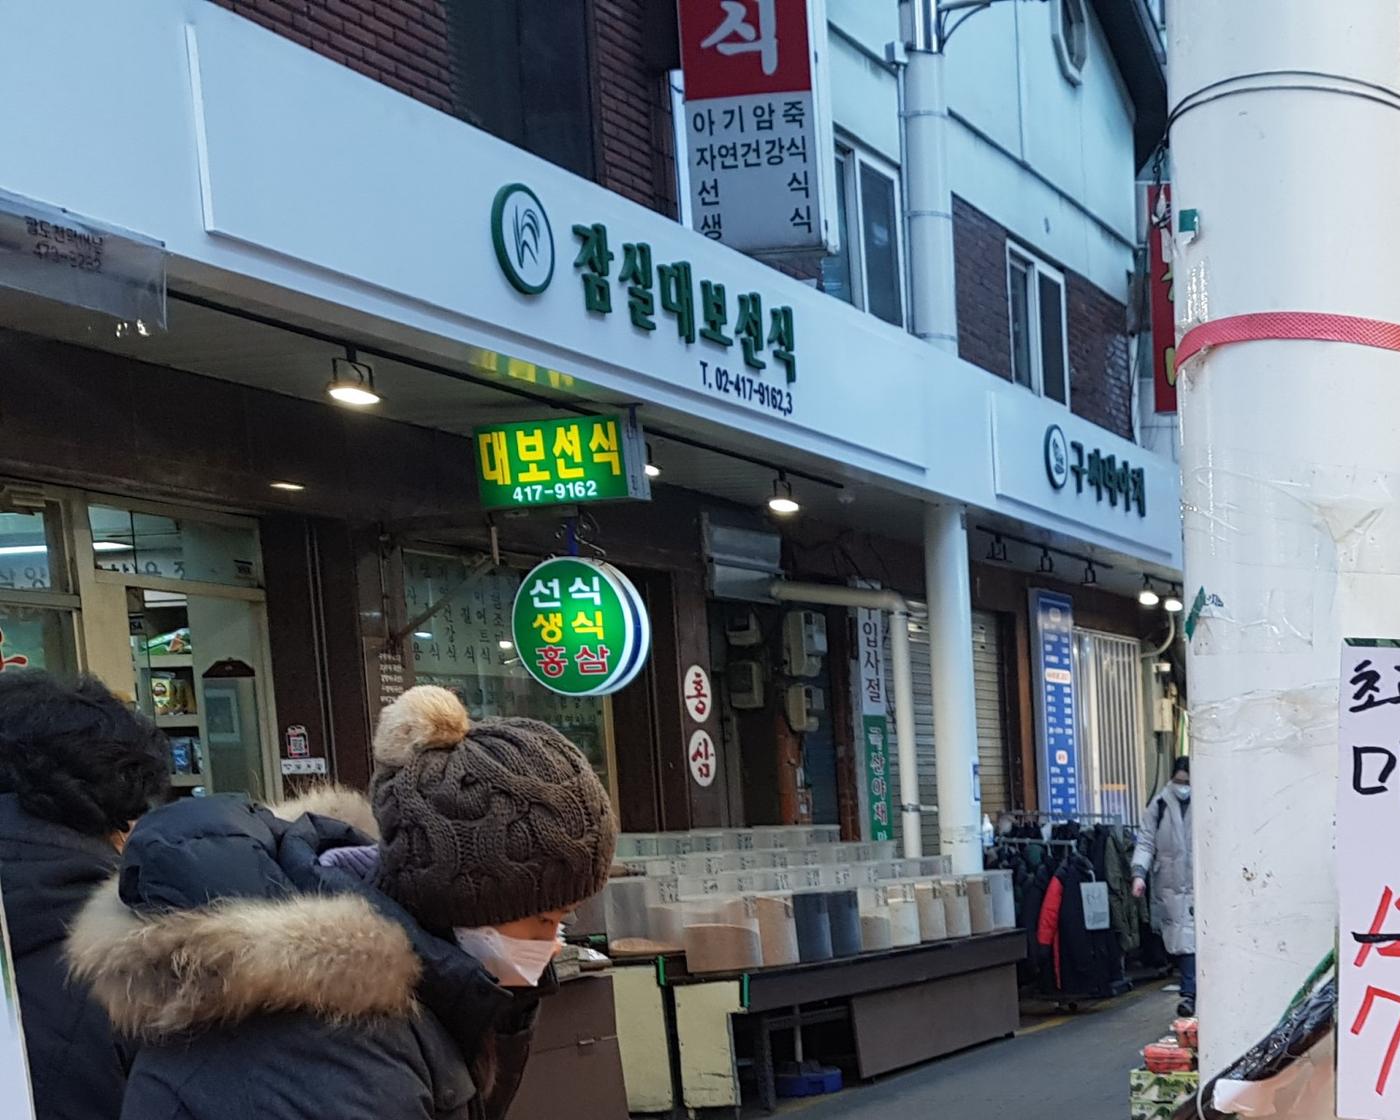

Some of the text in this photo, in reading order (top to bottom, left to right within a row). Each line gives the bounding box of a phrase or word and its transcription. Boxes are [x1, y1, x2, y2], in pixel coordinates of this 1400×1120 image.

[696, 135, 808, 172] 자연건강식
[478, 420, 621, 486] 대보선식
[512, 480, 598, 503] 417-9162
[529, 576, 602, 608] 선식
[532, 611, 605, 643] 생식
[534, 645, 611, 678] 홍삼
